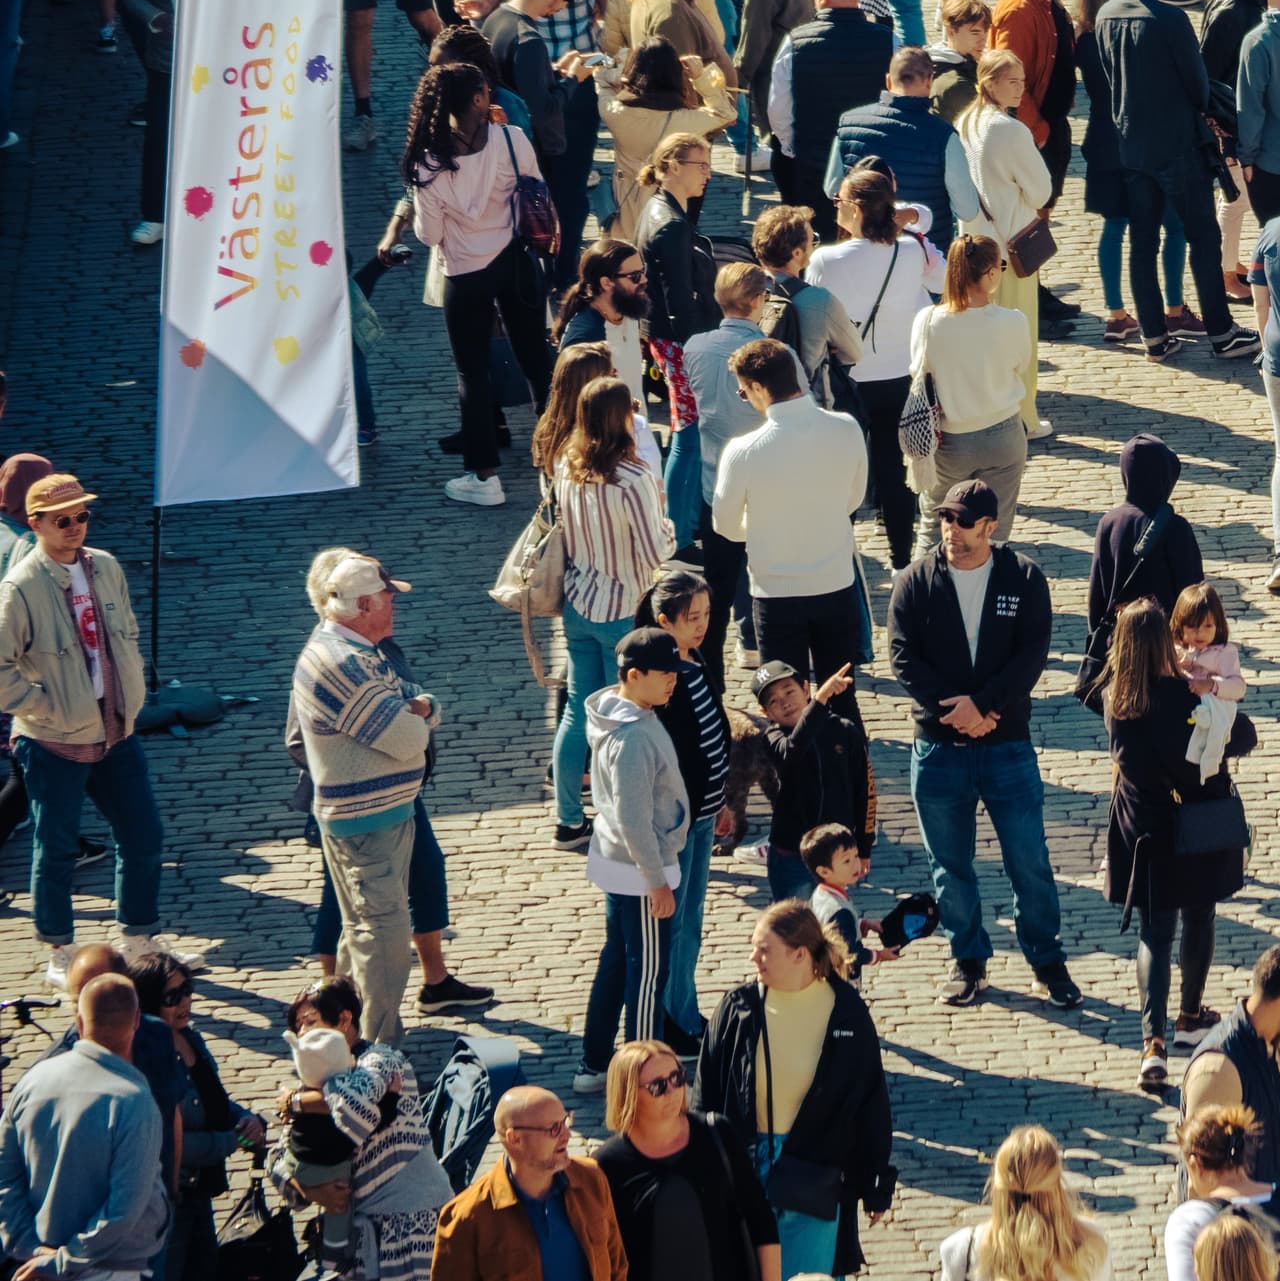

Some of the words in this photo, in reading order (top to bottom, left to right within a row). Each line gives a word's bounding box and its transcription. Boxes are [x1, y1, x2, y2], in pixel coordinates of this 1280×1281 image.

[280, 16, 302, 121] FOOD
[214, 22, 276, 311] Västerås
[273, 144, 301, 302] STREET
